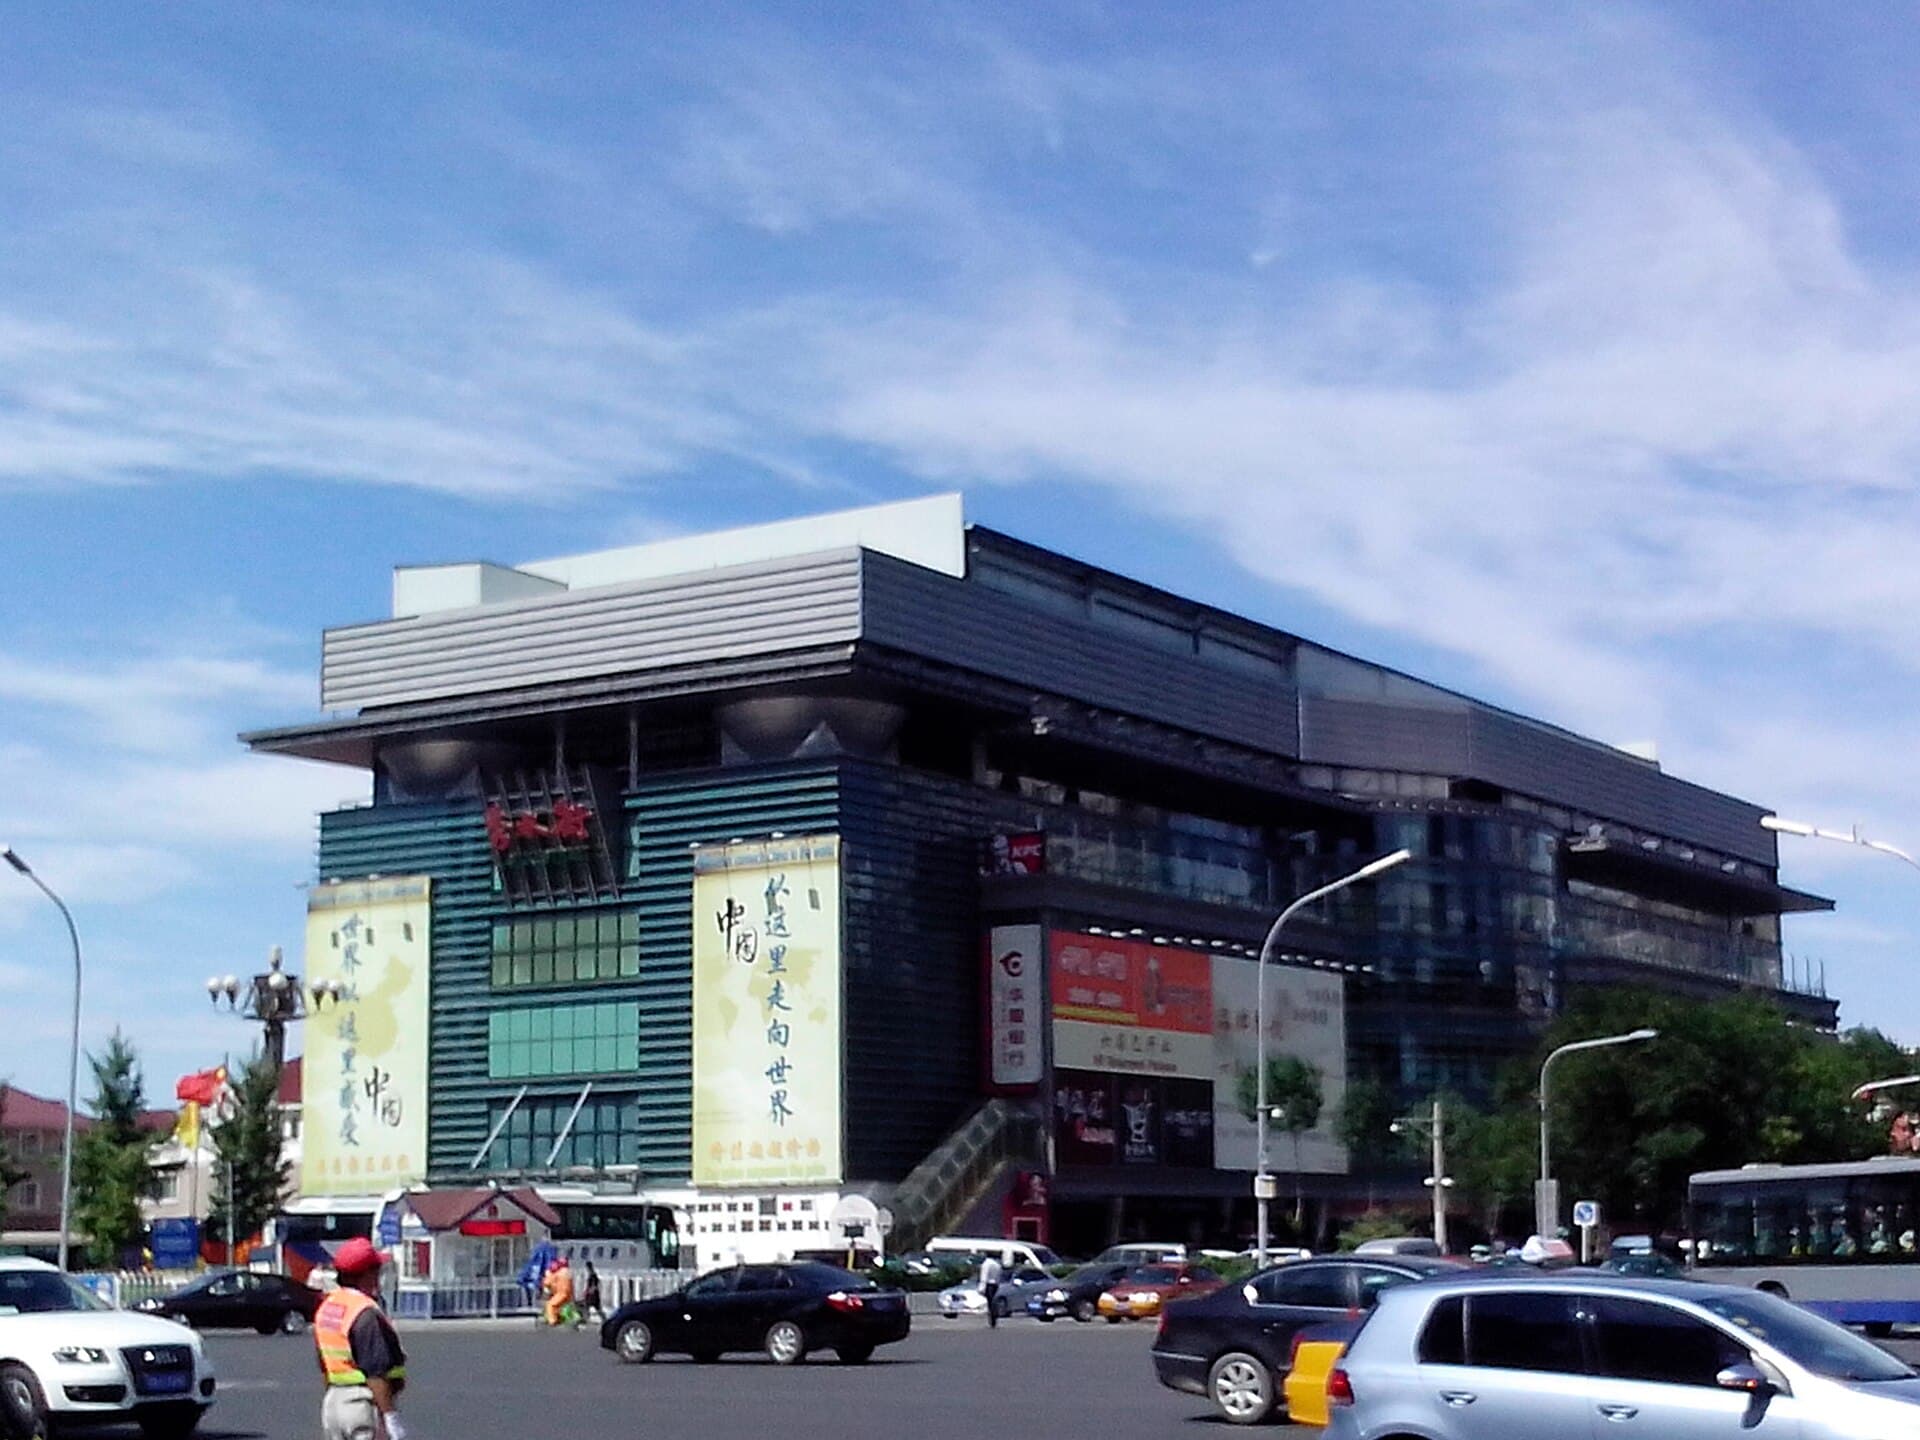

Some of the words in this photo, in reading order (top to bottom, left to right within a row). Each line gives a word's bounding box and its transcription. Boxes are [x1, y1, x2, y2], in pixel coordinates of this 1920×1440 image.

[716, 897, 758, 964] 中国
[764, 872, 793, 1127] 从这里走向世界
[364, 1065, 403, 1128] 中国
